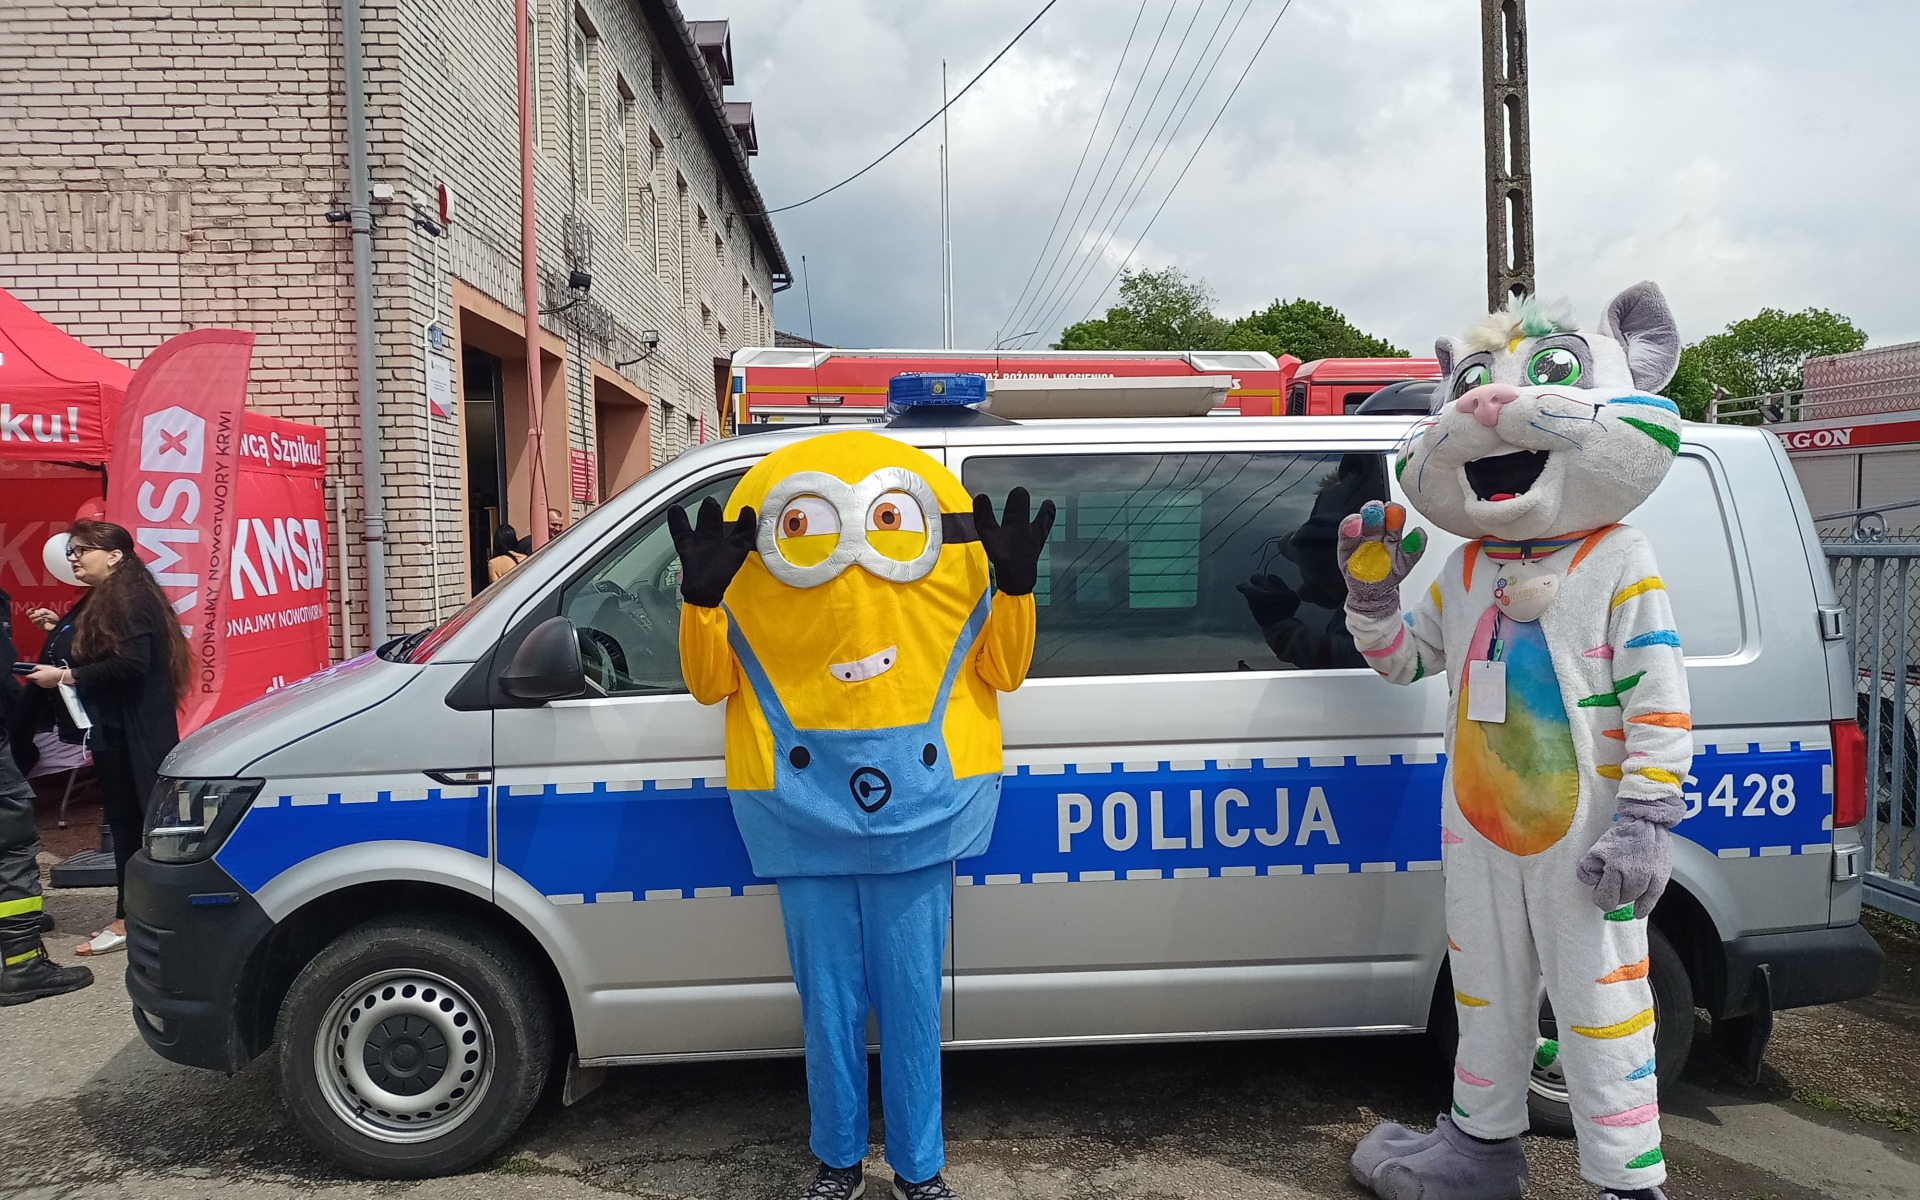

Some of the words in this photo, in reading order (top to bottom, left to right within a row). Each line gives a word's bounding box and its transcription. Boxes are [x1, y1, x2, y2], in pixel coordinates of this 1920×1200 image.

[215, 410, 232, 457] KRWI
[270, 431, 321, 468] Szpiku!
[209, 463, 229, 581] NOWOTWORY
[201, 588, 219, 694] POKONAJMY
[1057, 786, 1341, 853] POLICJA
